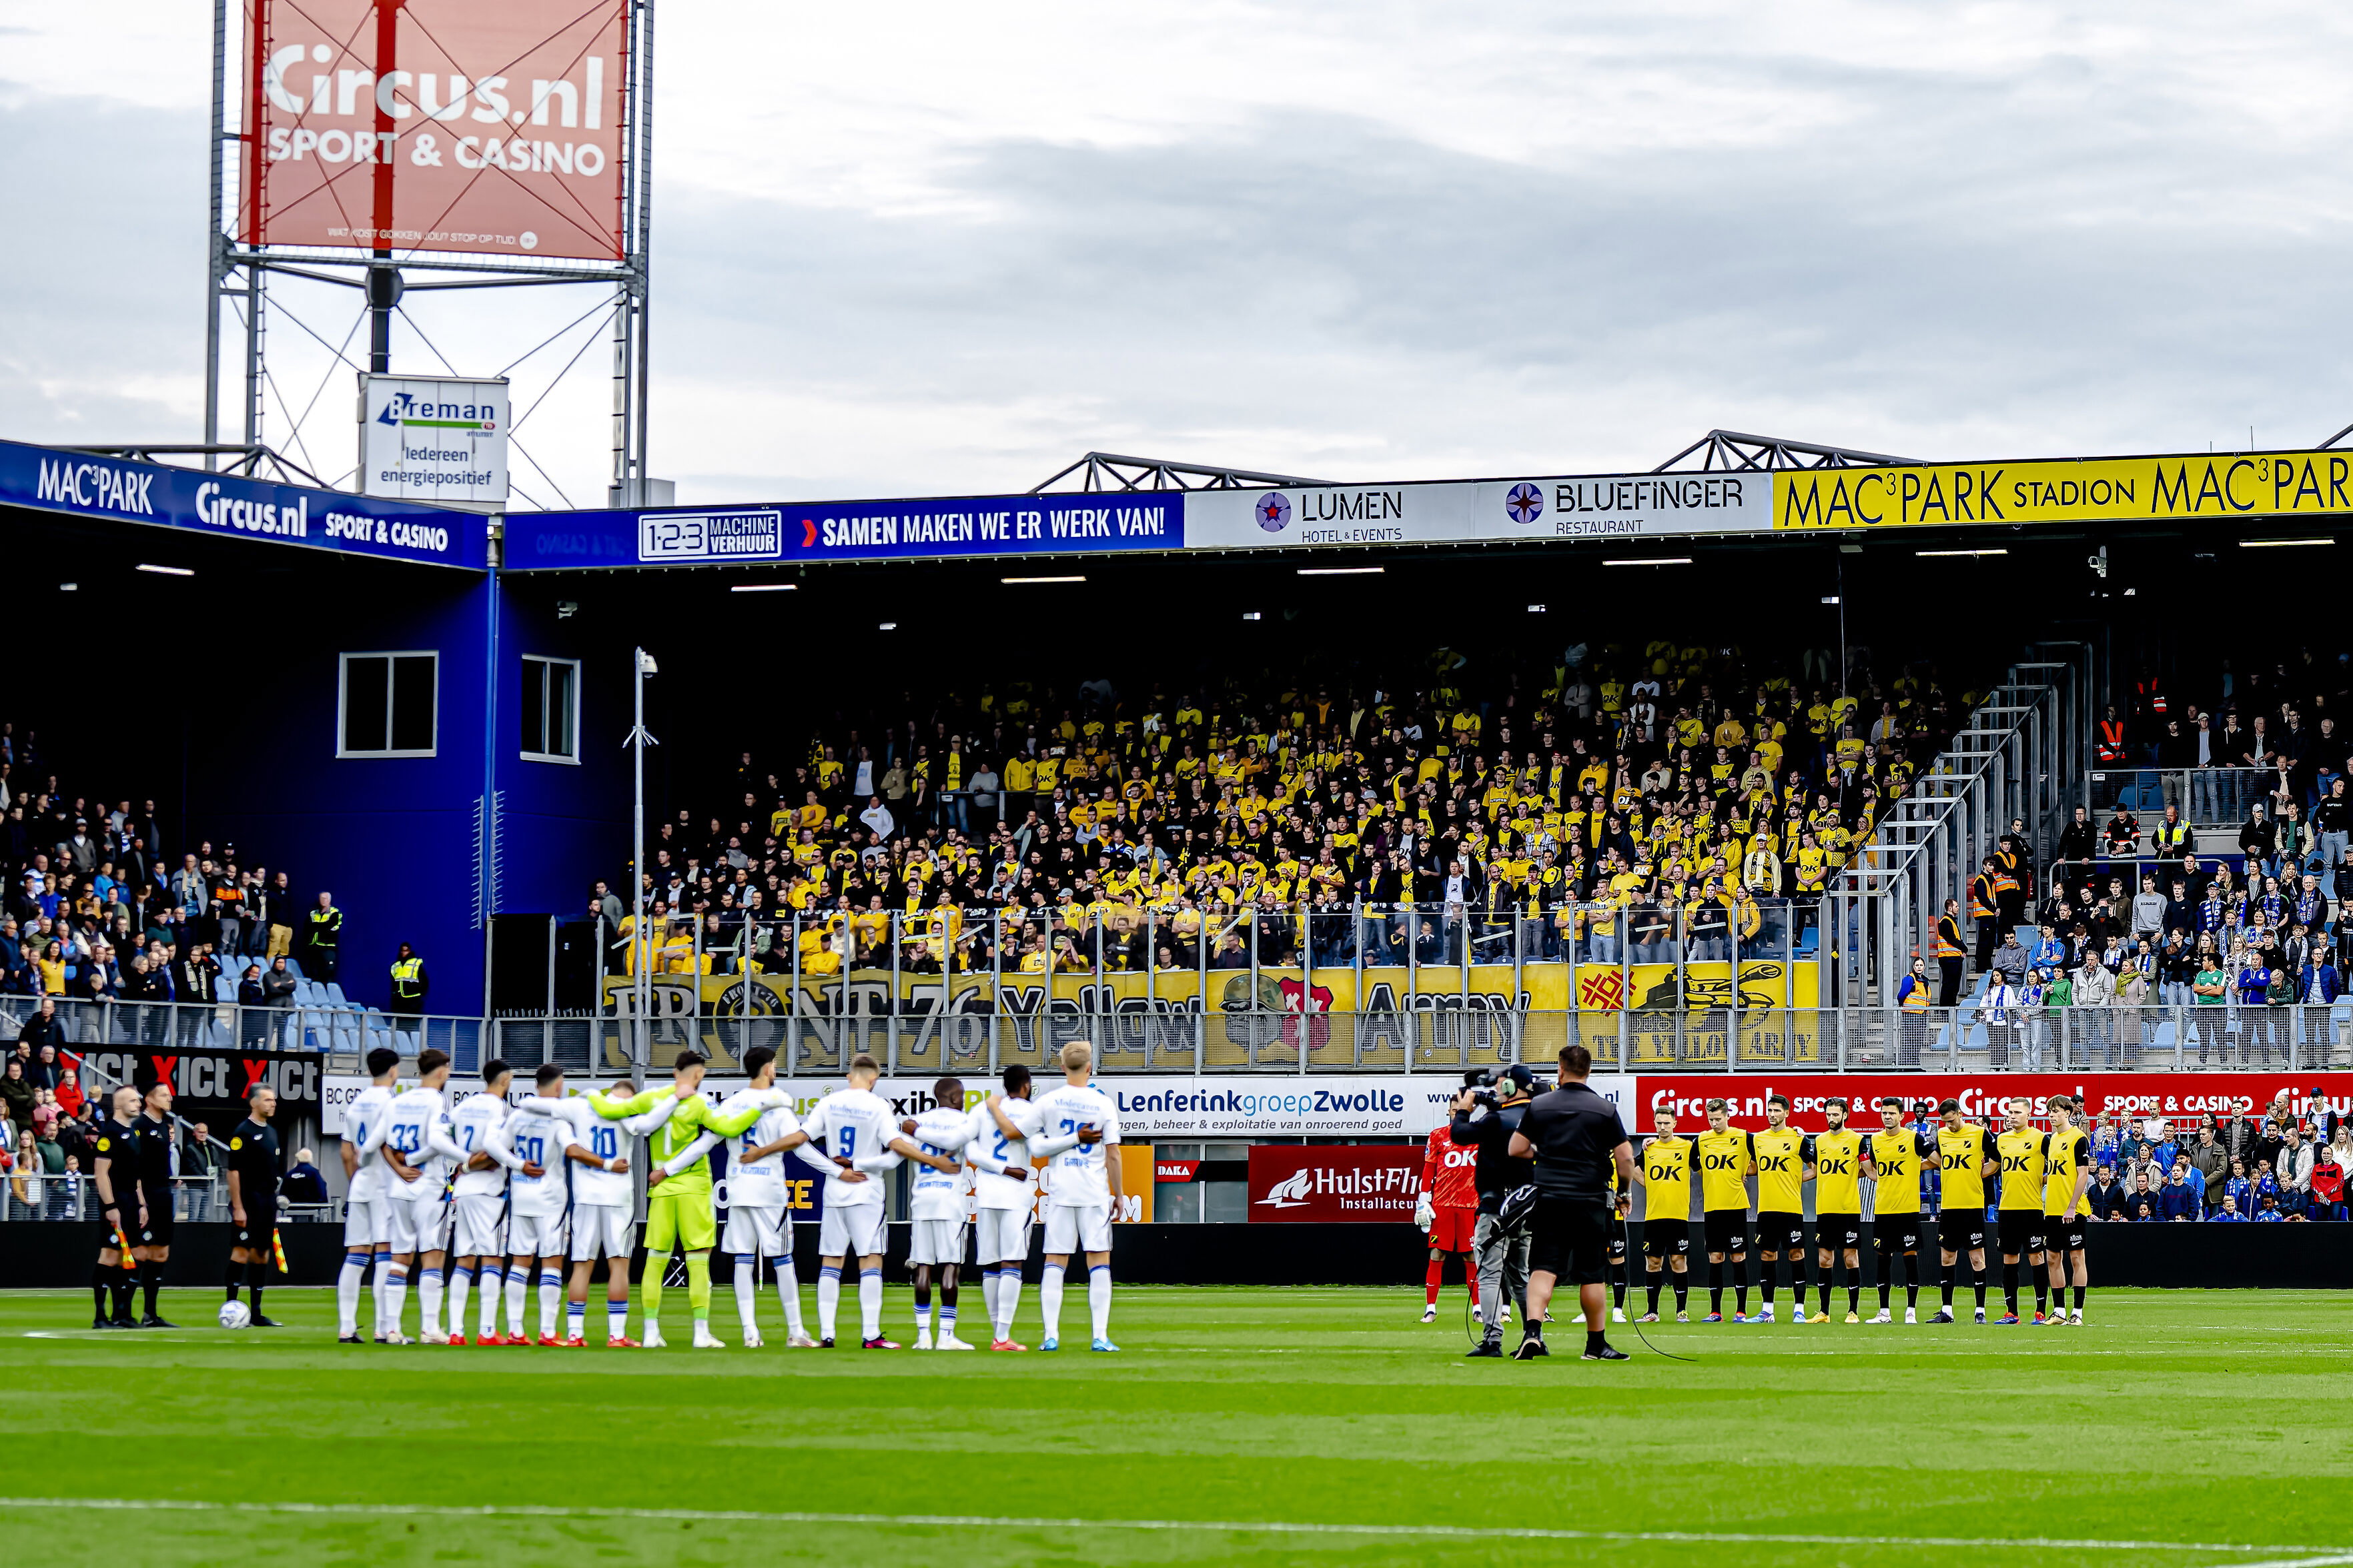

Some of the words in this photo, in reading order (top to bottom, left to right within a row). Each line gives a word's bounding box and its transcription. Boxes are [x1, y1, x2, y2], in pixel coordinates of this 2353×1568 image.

[264, 44, 604, 130] Circus.nl
[268, 127, 398, 164] SPORT
[410, 134, 443, 167] &
[455, 136, 606, 176] CASINO
[389, 396, 494, 420] Breman
[406, 448, 468, 462] Iedereen
[381, 470, 492, 486] energiepositief
[1556, 479, 1743, 512] BLUEFINGER
[2013, 479, 2134, 508] STADION
[1302, 491, 1402, 522] LUMEN
[196, 482, 307, 538] Circus.nl
[326, 513, 375, 542] SPORT
[376, 523, 388, 544] &
[391, 522, 448, 552] CASINO
[710, 517, 776, 536] MACHINE
[823, 518, 897, 546] SAMEN
[903, 513, 973, 543] MAKEN
[979, 512, 1010, 540] WE
[1017, 511, 1041, 539] ER
[1050, 508, 1111, 538] WERK
[1117, 507, 1165, 535] VAN!
[1302, 531, 1344, 542] HOTEL
[1353, 528, 1402, 542] EVENTS
[1556, 520, 1644, 535] RESTAURANT
[710, 534, 777, 553] VERHUUR
[1038, 775, 1052, 783] OK
[1634, 865, 1649, 874] OK
[1801, 864, 1817, 873] OK
[911, 984, 983, 1055] 76
[1853, 1097, 1866, 1112] &
[1870, 1096, 1939, 1112] CSINO
[2165, 1096, 2178, 1112] &
[1153, 1119, 1196, 1130] beheer
[1200, 1120, 1208, 1129] &
[1212, 1119, 1276, 1132] exploitatie
[1280, 1122, 1302, 1130] van
[1306, 1120, 1369, 1130] onroerend
[1372, 1120, 1403, 1132] goed
[392, 1124, 420, 1154] 33
[591, 1126, 616, 1158] 10
[664, 1122, 672, 1156] 1
[839, 1126, 856, 1157] 9
[993, 1130, 1008, 1161] 2
[1444, 1150, 1477, 1167] OK
[1705, 1154, 1739, 1170] OK
[1759, 1156, 1790, 1172] OK
[1820, 1159, 1850, 1174] OK
[1941, 1154, 1972, 1169] OK
[2002, 1156, 2031, 1172] OK
[1157, 1166, 1190, 1176] DAKA
[1649, 1165, 1683, 1182] OK
[1877, 1160, 1905, 1177] OK
